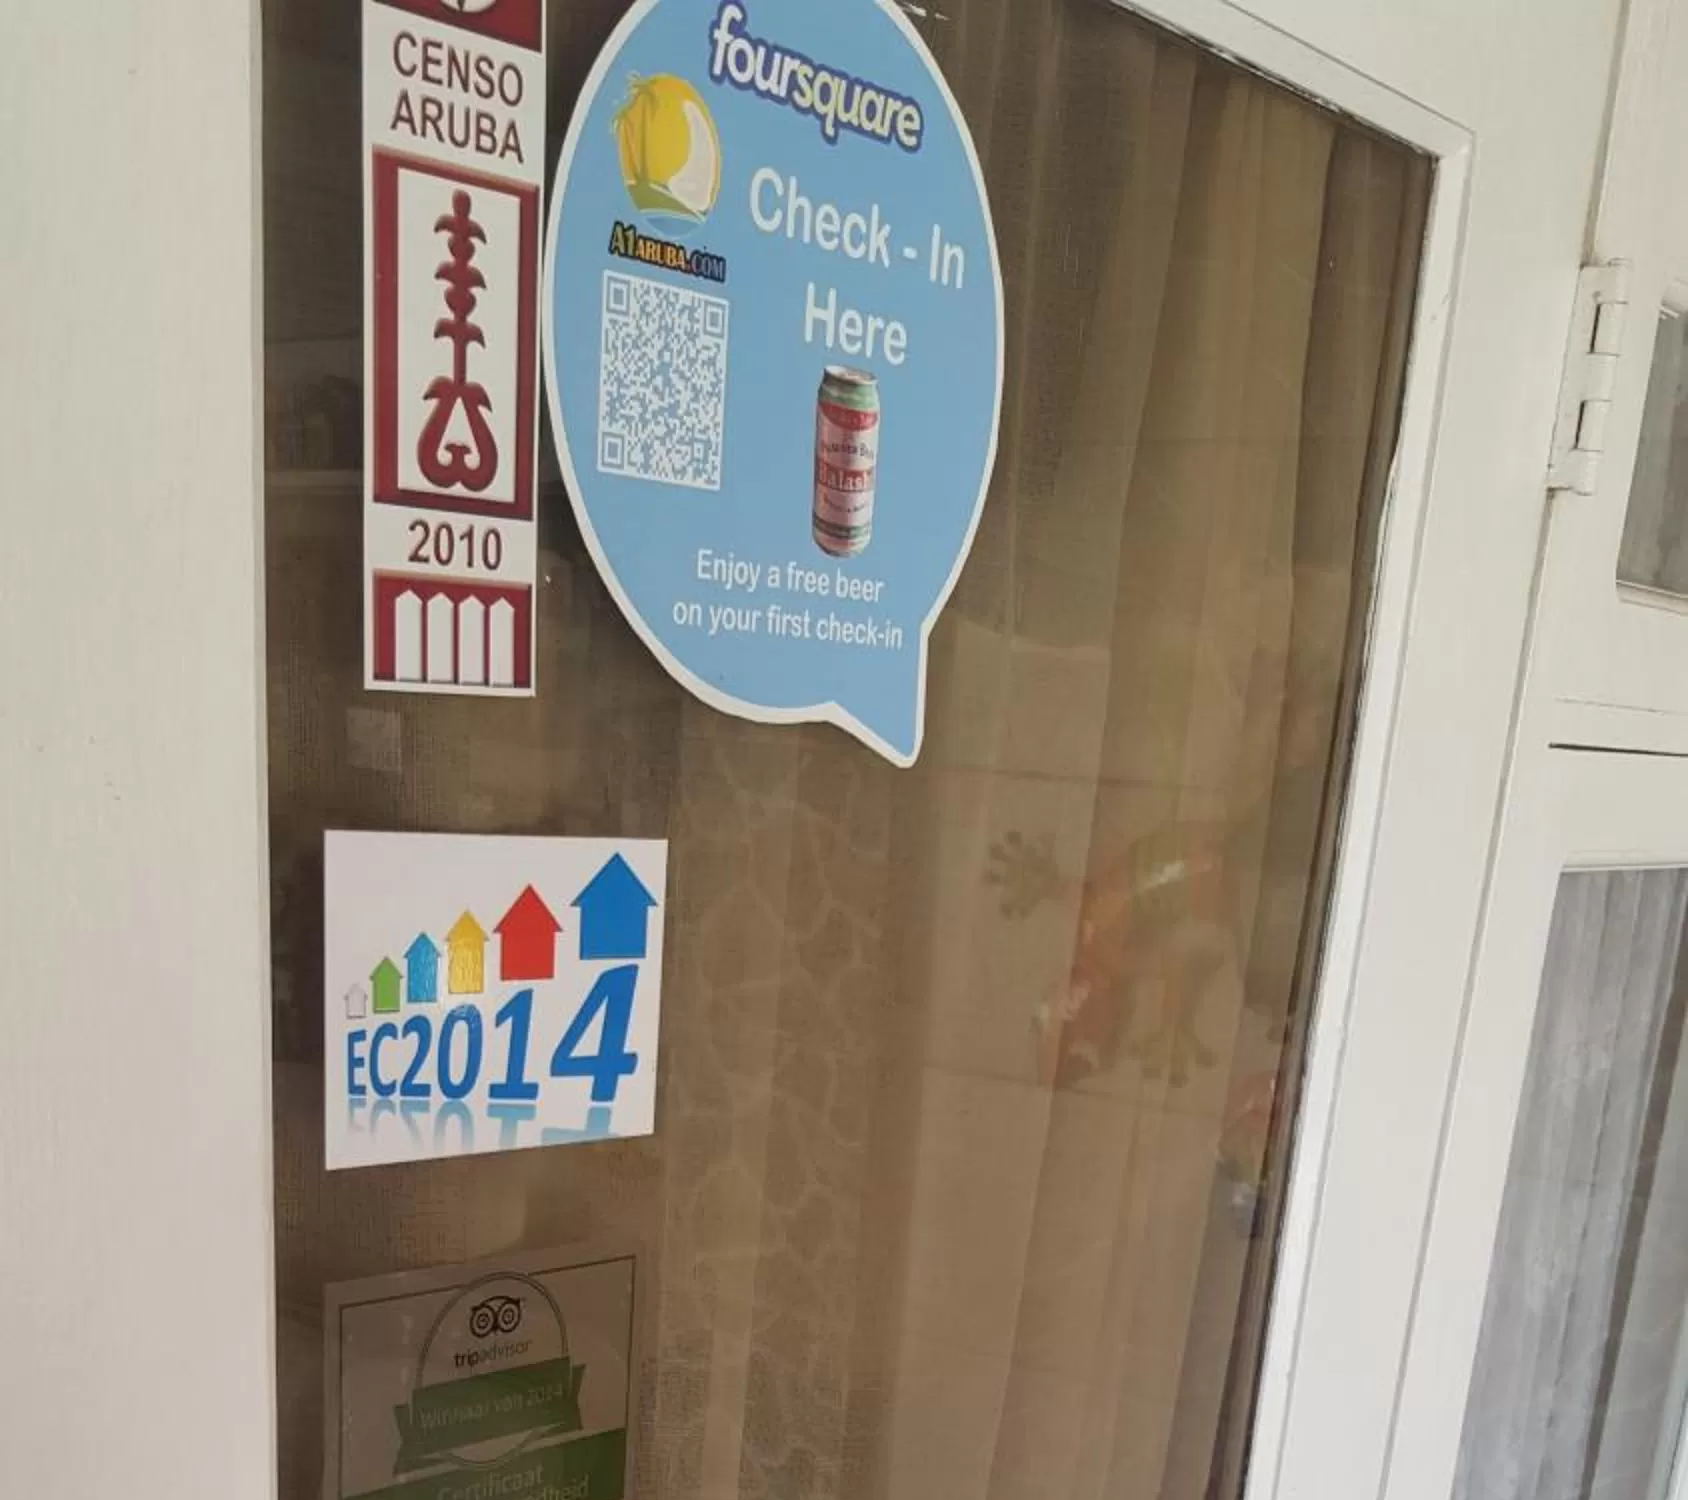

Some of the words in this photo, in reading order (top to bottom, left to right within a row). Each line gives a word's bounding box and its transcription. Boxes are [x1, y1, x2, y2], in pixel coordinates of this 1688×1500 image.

[392, 30, 524, 108] CENSO
[710, 2, 922, 150] foursquare
[390, 88, 524, 165] ARUBA
[749, 167, 892, 269] Check
[929, 223, 966, 289] In
[804, 281, 908, 365] Here
[407, 519, 503, 571] 2010
[697, 548, 761, 593] Enjoy
[767, 565, 781, 589] a
[787, 561, 830, 596] free
[835, 567, 885, 603] beer
[673, 601, 702, 626] on
[708, 603, 762, 637] your
[767, 604, 812, 639] first
[816, 612, 904, 650] check-in
[346, 963, 640, 1103] EC2014
